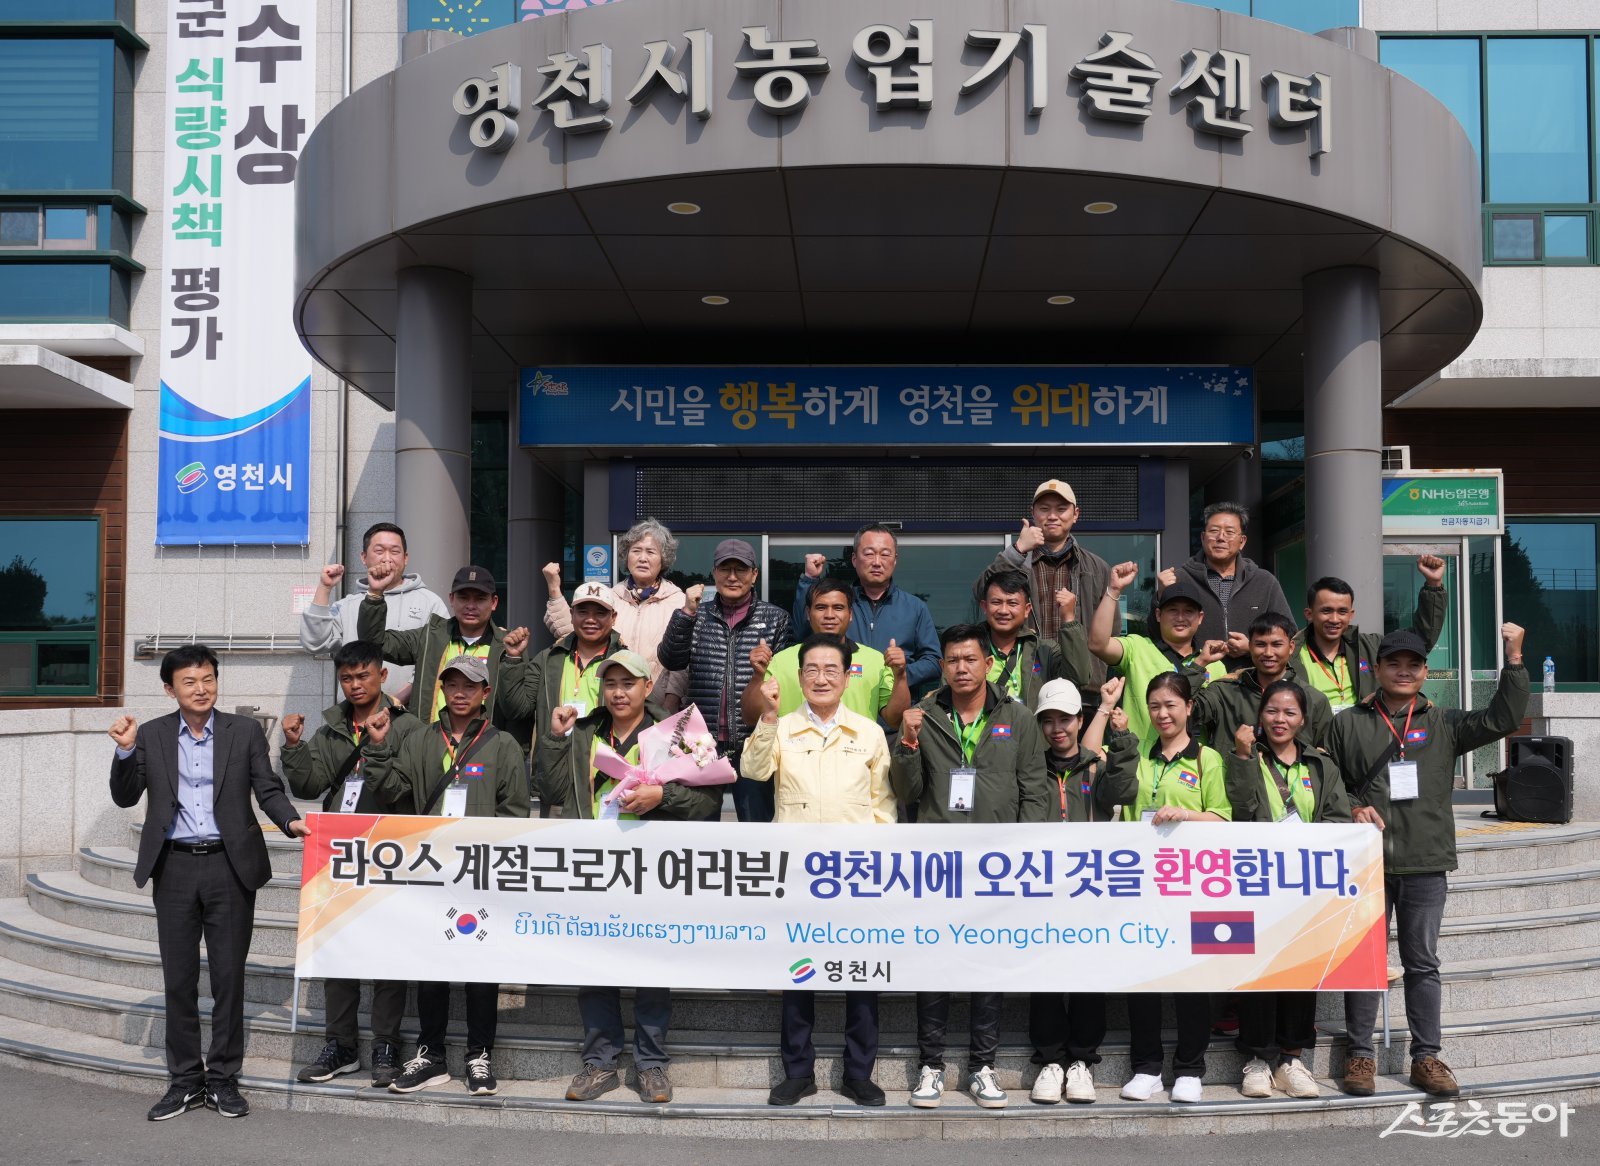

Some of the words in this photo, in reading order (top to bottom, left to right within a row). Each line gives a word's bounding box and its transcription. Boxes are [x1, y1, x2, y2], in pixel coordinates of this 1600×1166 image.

[234, 5, 305, 185] 수상
[171, 57, 227, 247] 식량시책
[171, 267, 223, 360] 평가
[609, 385, 711, 426] 시민을
[718, 381, 879, 430] 행복하게
[899, 385, 998, 425] 영천을
[1011, 382, 1168, 427] 위대하게
[213, 463, 292, 491] 영천시
[1441, 517, 1490, 526] 현금자동지급기
[587, 586, 601, 596] M
[331, 839, 444, 887] 라오스
[453, 843, 648, 894] 계절근로자
[657, 848, 790, 899] 여러분!
[804, 850, 963, 899] 영천시에
[974, 849, 1053, 897] 오신
[1065, 849, 1144, 897] 것을
[1153, 847, 1358, 898] 환영합니다.
[785, 922, 905, 945] Welcome
[914, 925, 940, 945] to
[948, 922, 1110, 949] Yeongcheon
[1119, 922, 1176, 949] City.
[823, 960, 892, 983] 영천시
